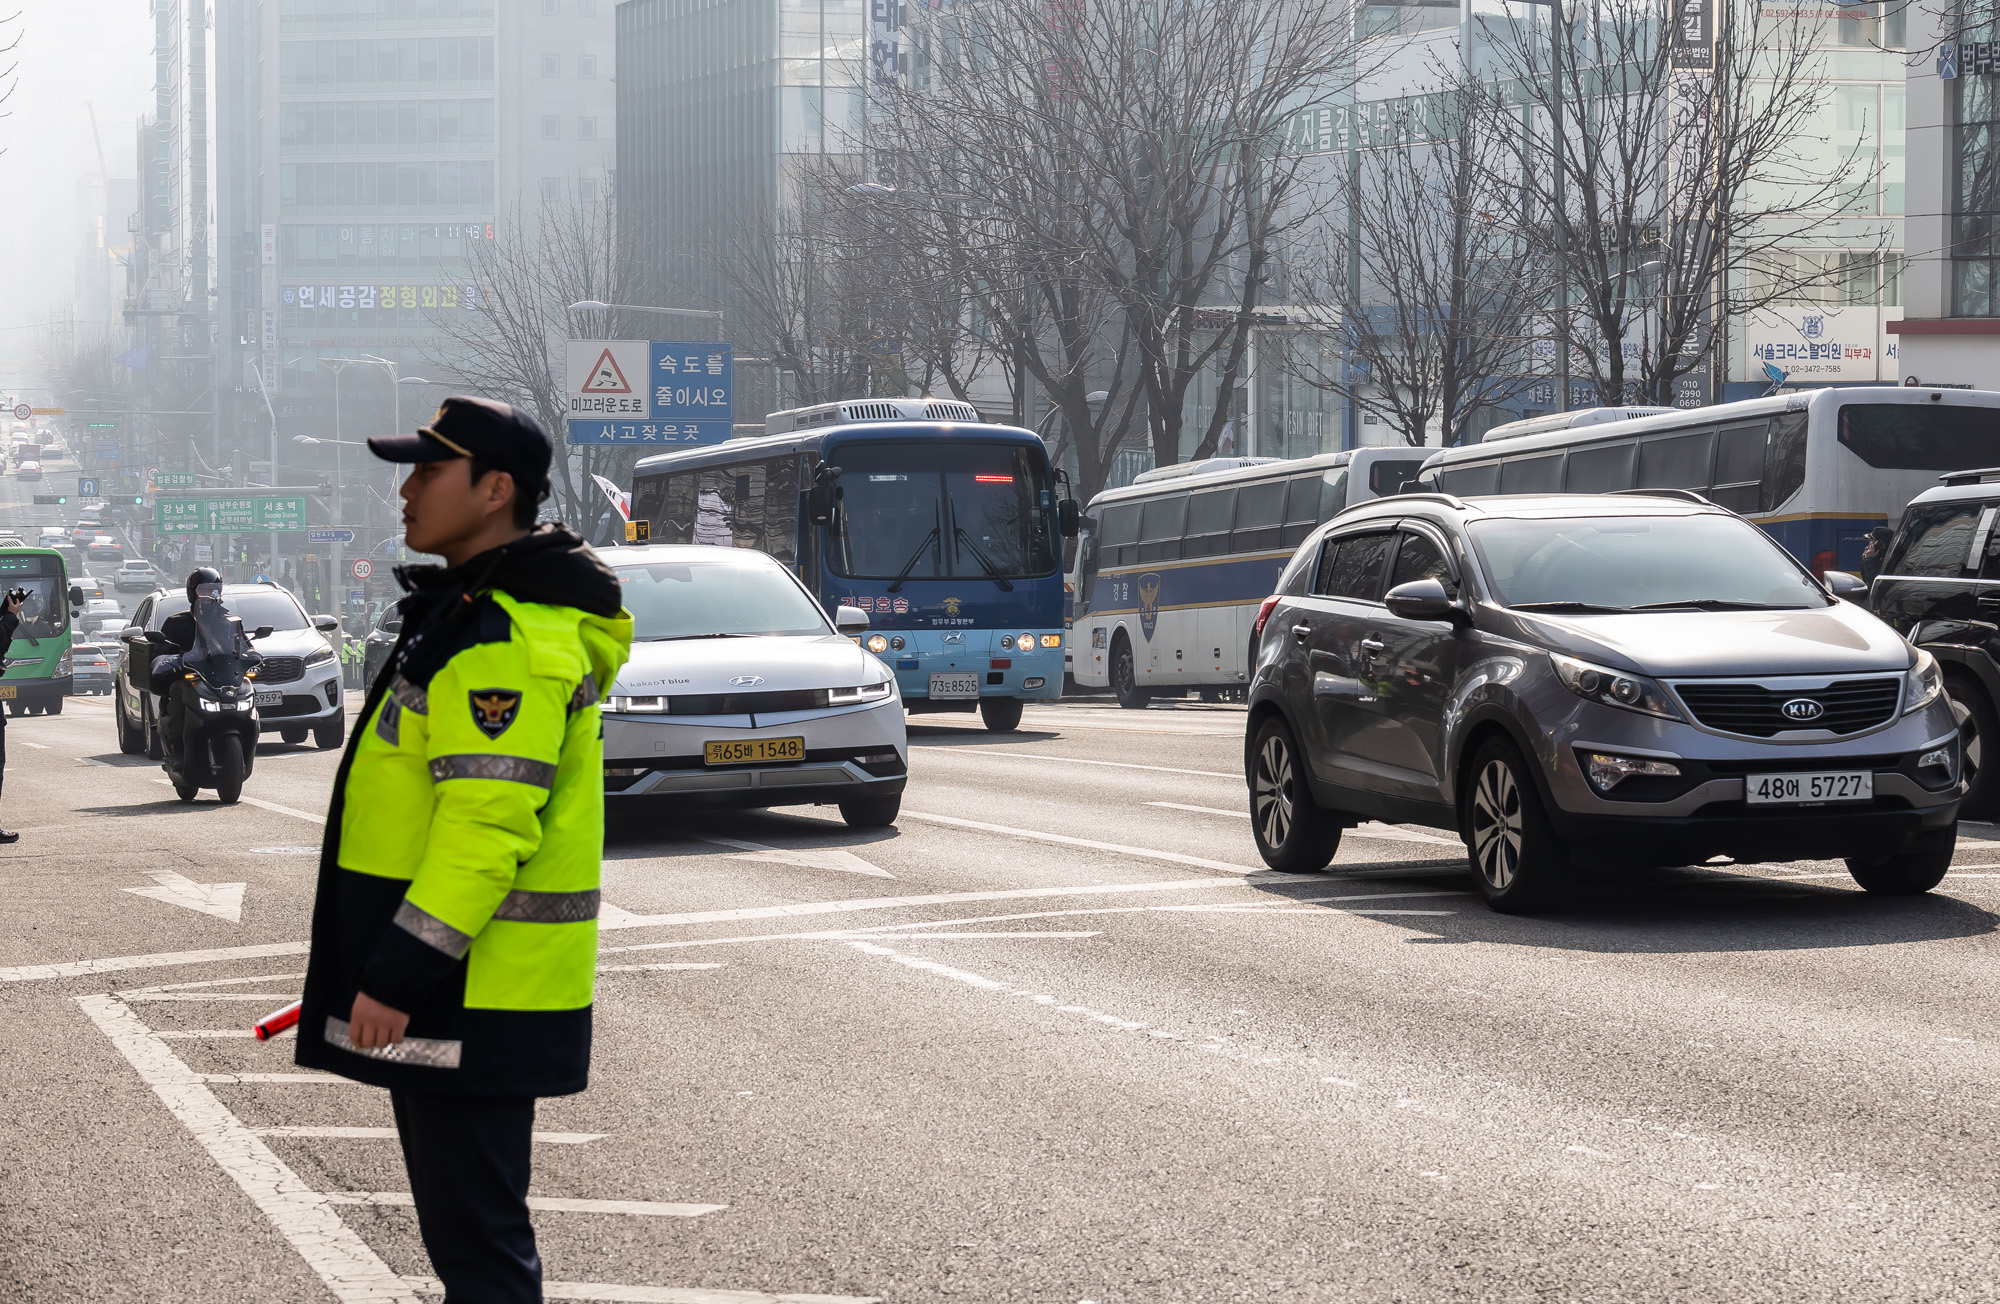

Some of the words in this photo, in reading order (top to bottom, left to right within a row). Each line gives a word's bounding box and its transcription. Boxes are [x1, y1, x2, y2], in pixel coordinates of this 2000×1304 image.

[1301, 106, 1349, 151] 지름길
[1753, 343, 1842, 360] 서울크리스탈의원
[1844, 347, 1872, 360] 피부과
[658, 354, 725, 375] 속도를
[1683, 380, 1698, 389] 010
[655, 386, 728, 407] 줄이시오
[1679, 390, 1701, 398] 2990
[1679, 399, 1701, 407] 0690
[18, 408, 29, 416] 50
[1308, 411, 1323, 437] DIET
[356, 564, 370, 574] 50
[668, 677, 691, 685] blue
[1789, 704, 1818, 716] KIA
[758, 740, 799, 758] 1548
[1757, 777, 1800, 800] 48어
[1810, 775, 1863, 799] 5727
